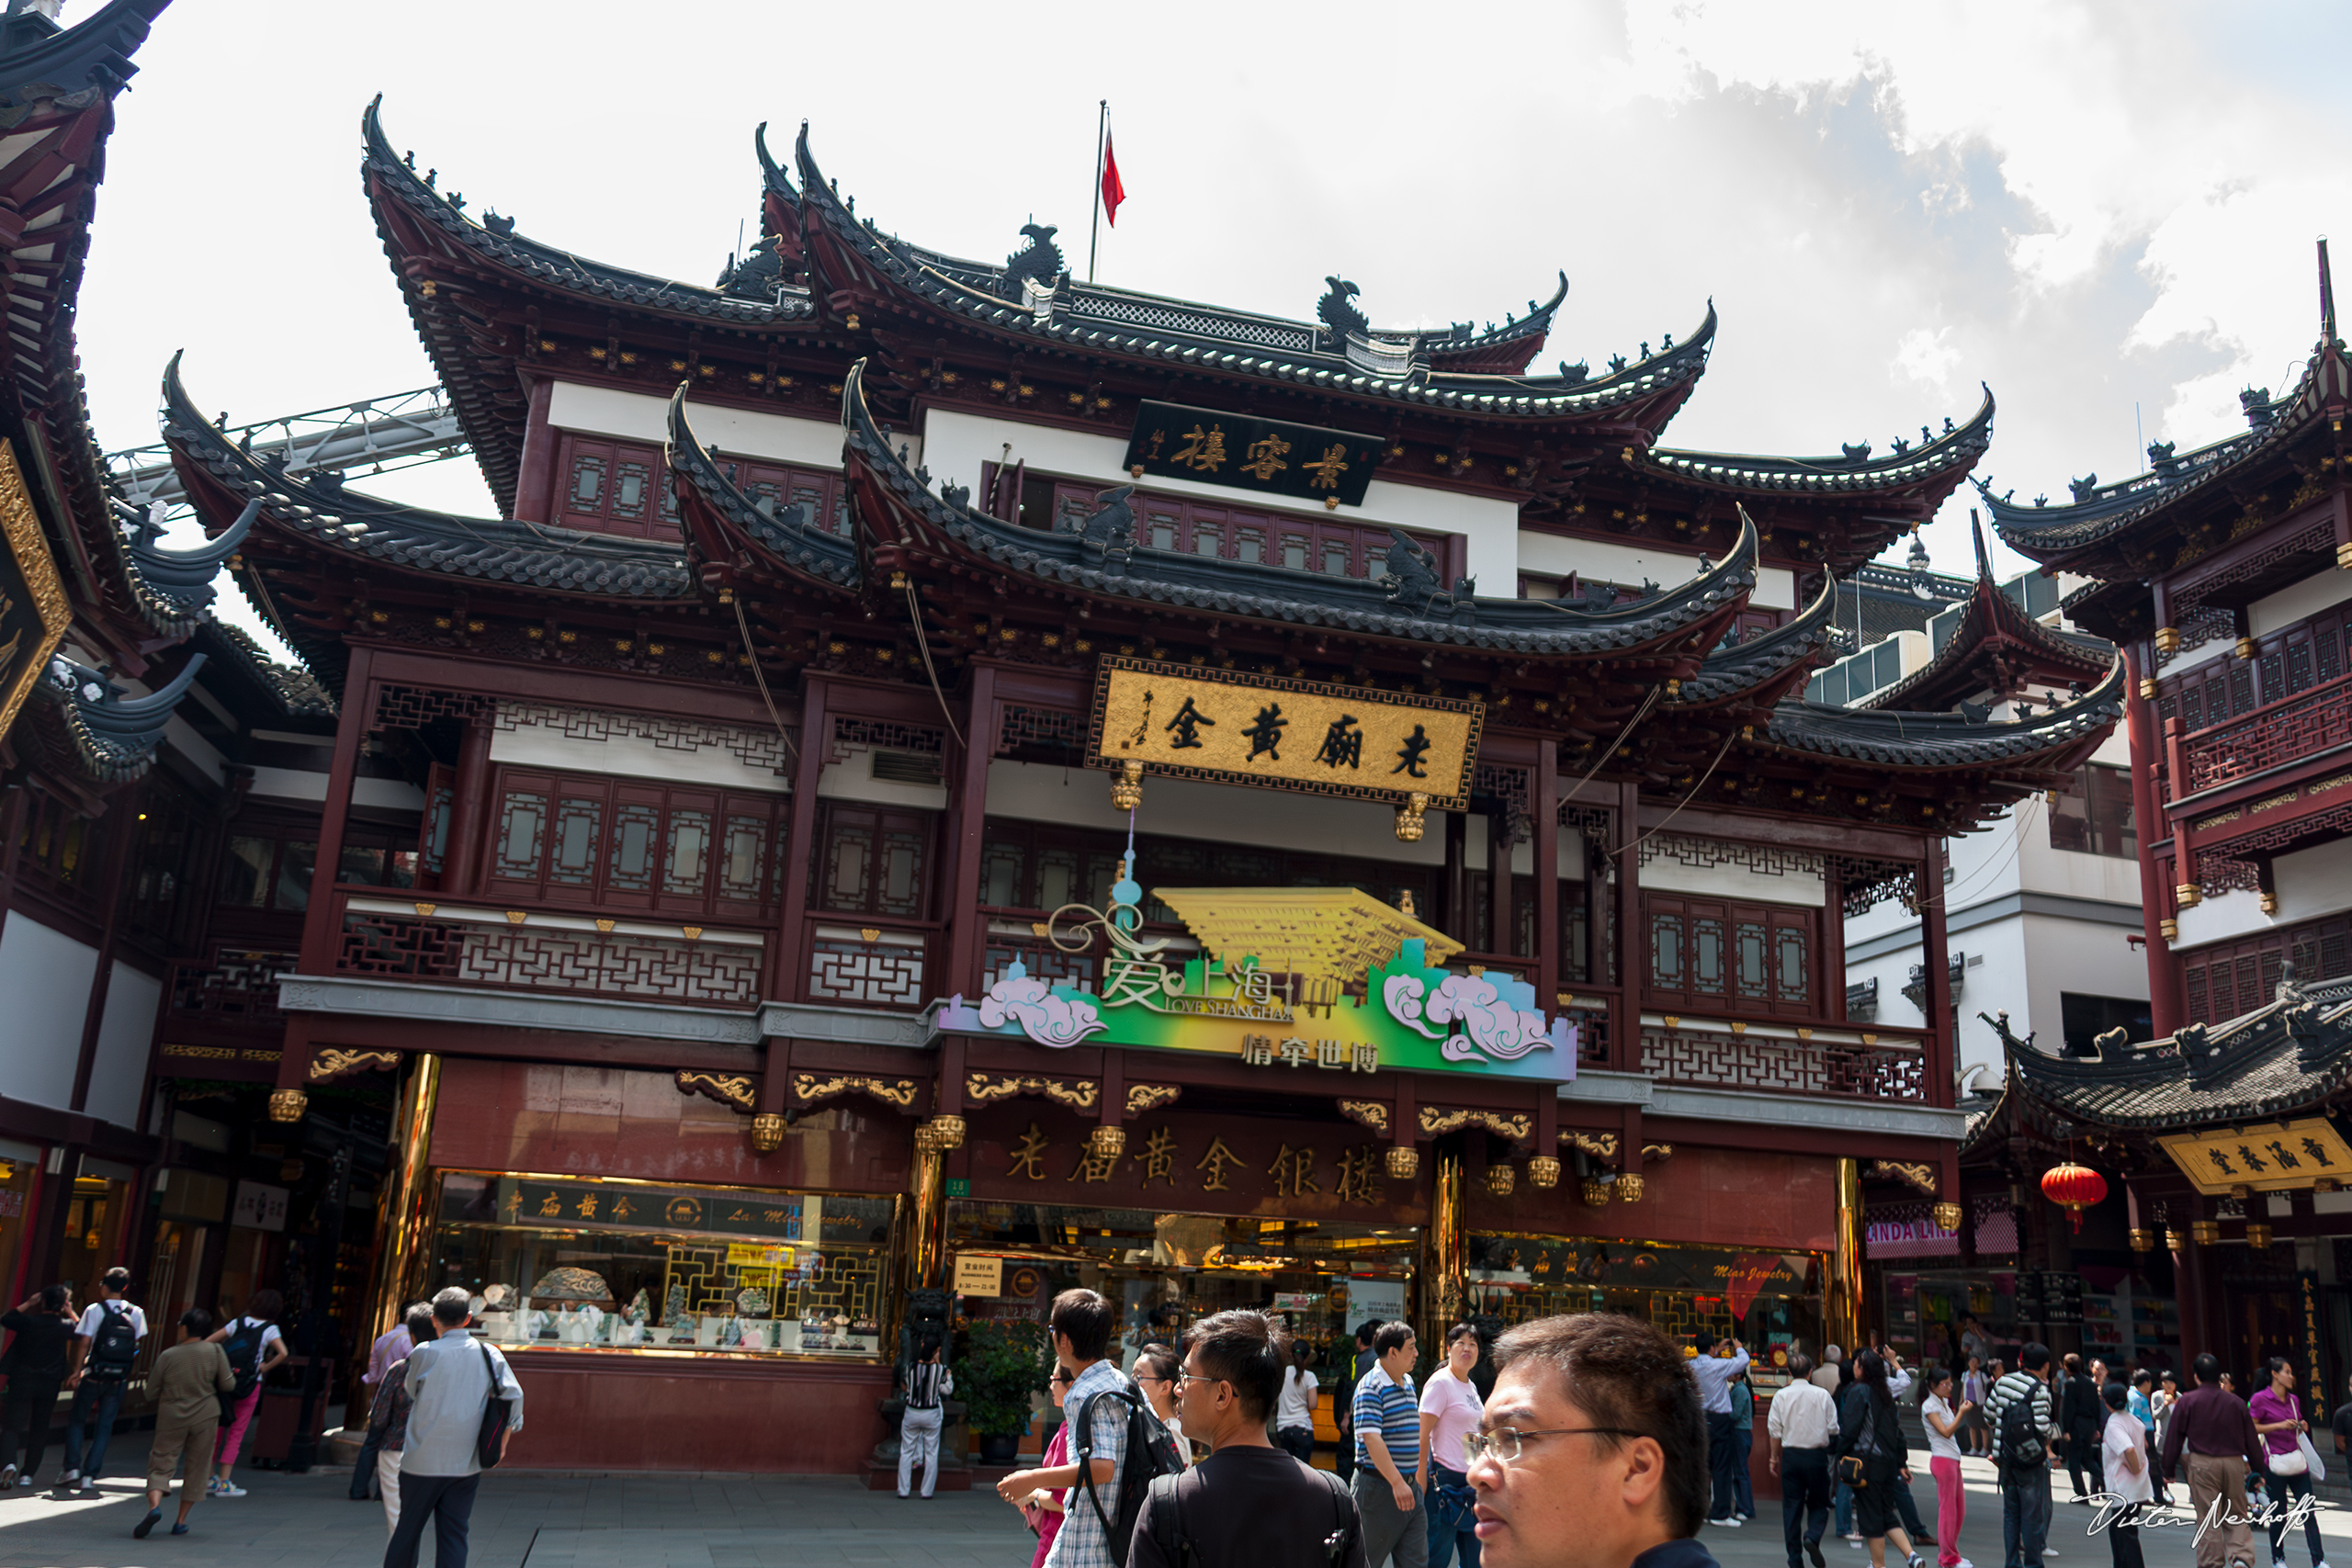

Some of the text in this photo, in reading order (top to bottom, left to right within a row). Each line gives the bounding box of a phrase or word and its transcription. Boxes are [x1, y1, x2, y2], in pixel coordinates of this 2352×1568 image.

[1165, 997, 1203, 1013] LOVE
[1241, 1033, 1378, 1075] 情牵世博
[953, 1180, 964, 1190] 18
[1866, 1223, 1913, 1243] LINDA
[1713, 1264, 1745, 1279] Miao
[1747, 1266, 1793, 1283] Jewelry
